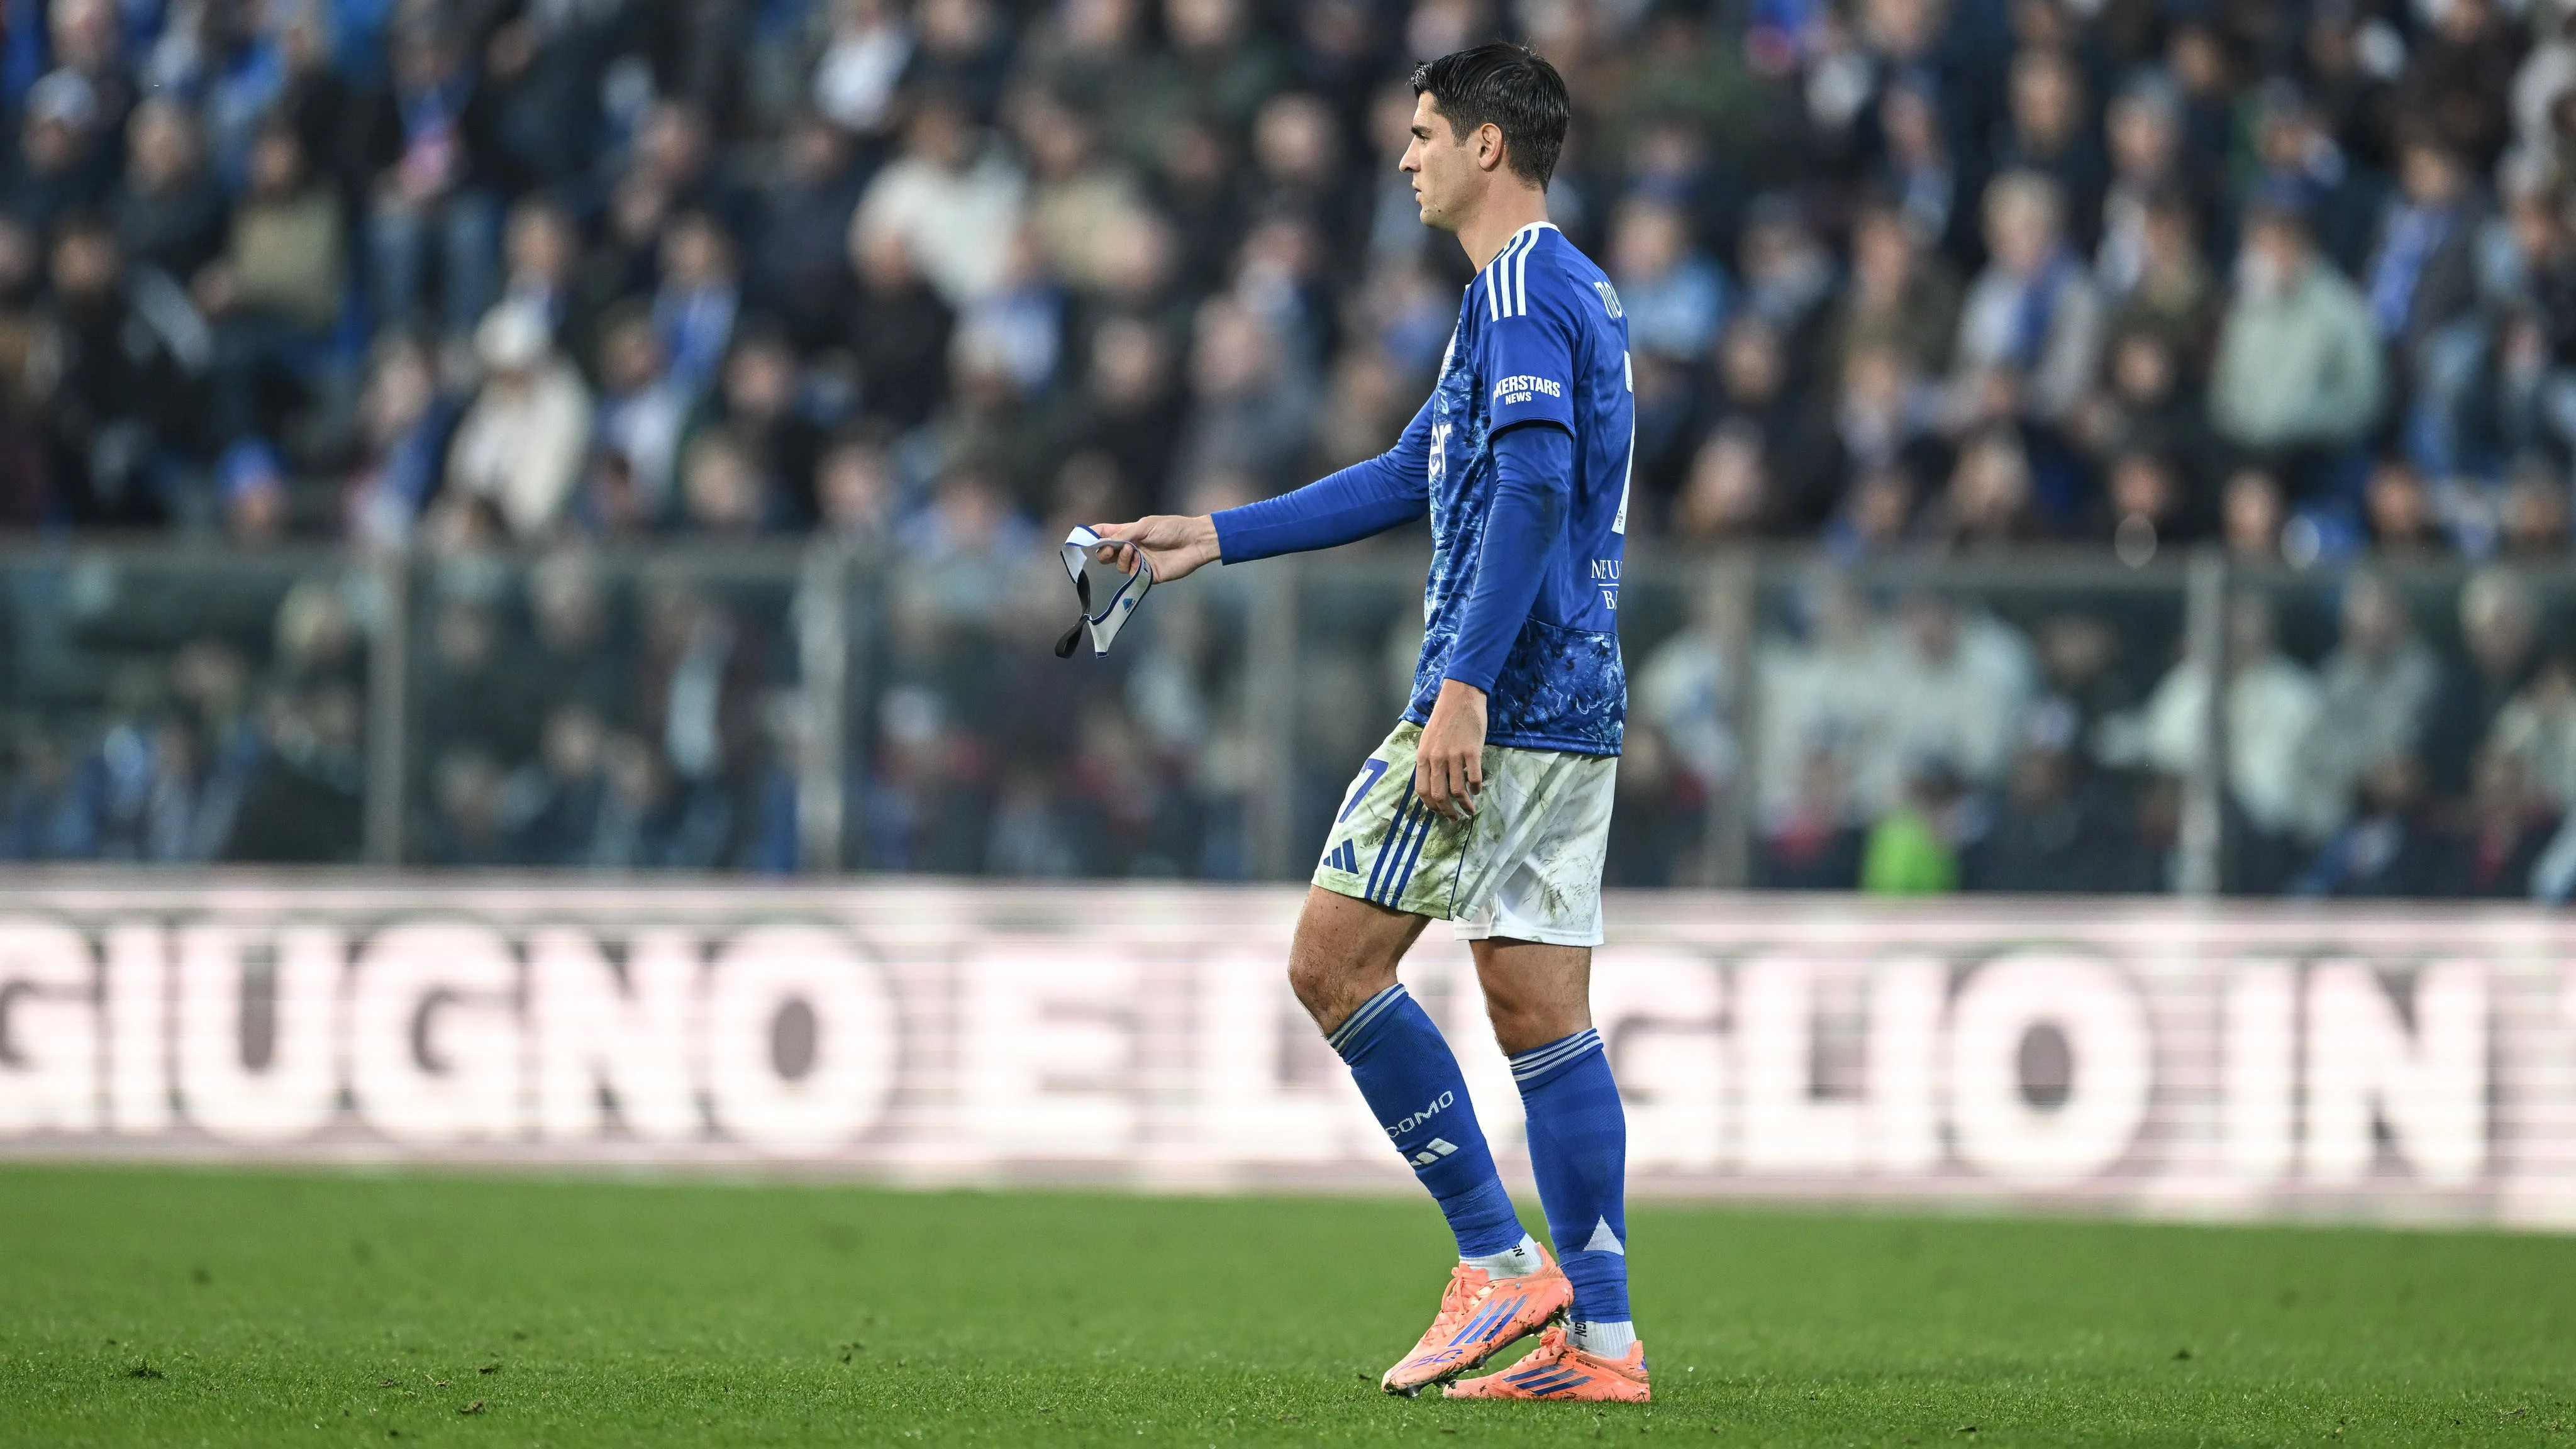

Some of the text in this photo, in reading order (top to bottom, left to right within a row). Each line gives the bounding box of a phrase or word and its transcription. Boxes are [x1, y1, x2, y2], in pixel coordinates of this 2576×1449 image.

[1594, 281, 1626, 319] MO
[1493, 375, 1560, 408] KERSTARS
[1505, 391, 1532, 405] NEWS
[1591, 558, 1623, 579] NEU
[1602, 590, 1618, 610] B
[1338, 758, 1389, 824] 7
[972, 940, 1135, 1158] E
[2223, 956, 2489, 1187] IN
[1385, 1091, 1454, 1138] COMO
